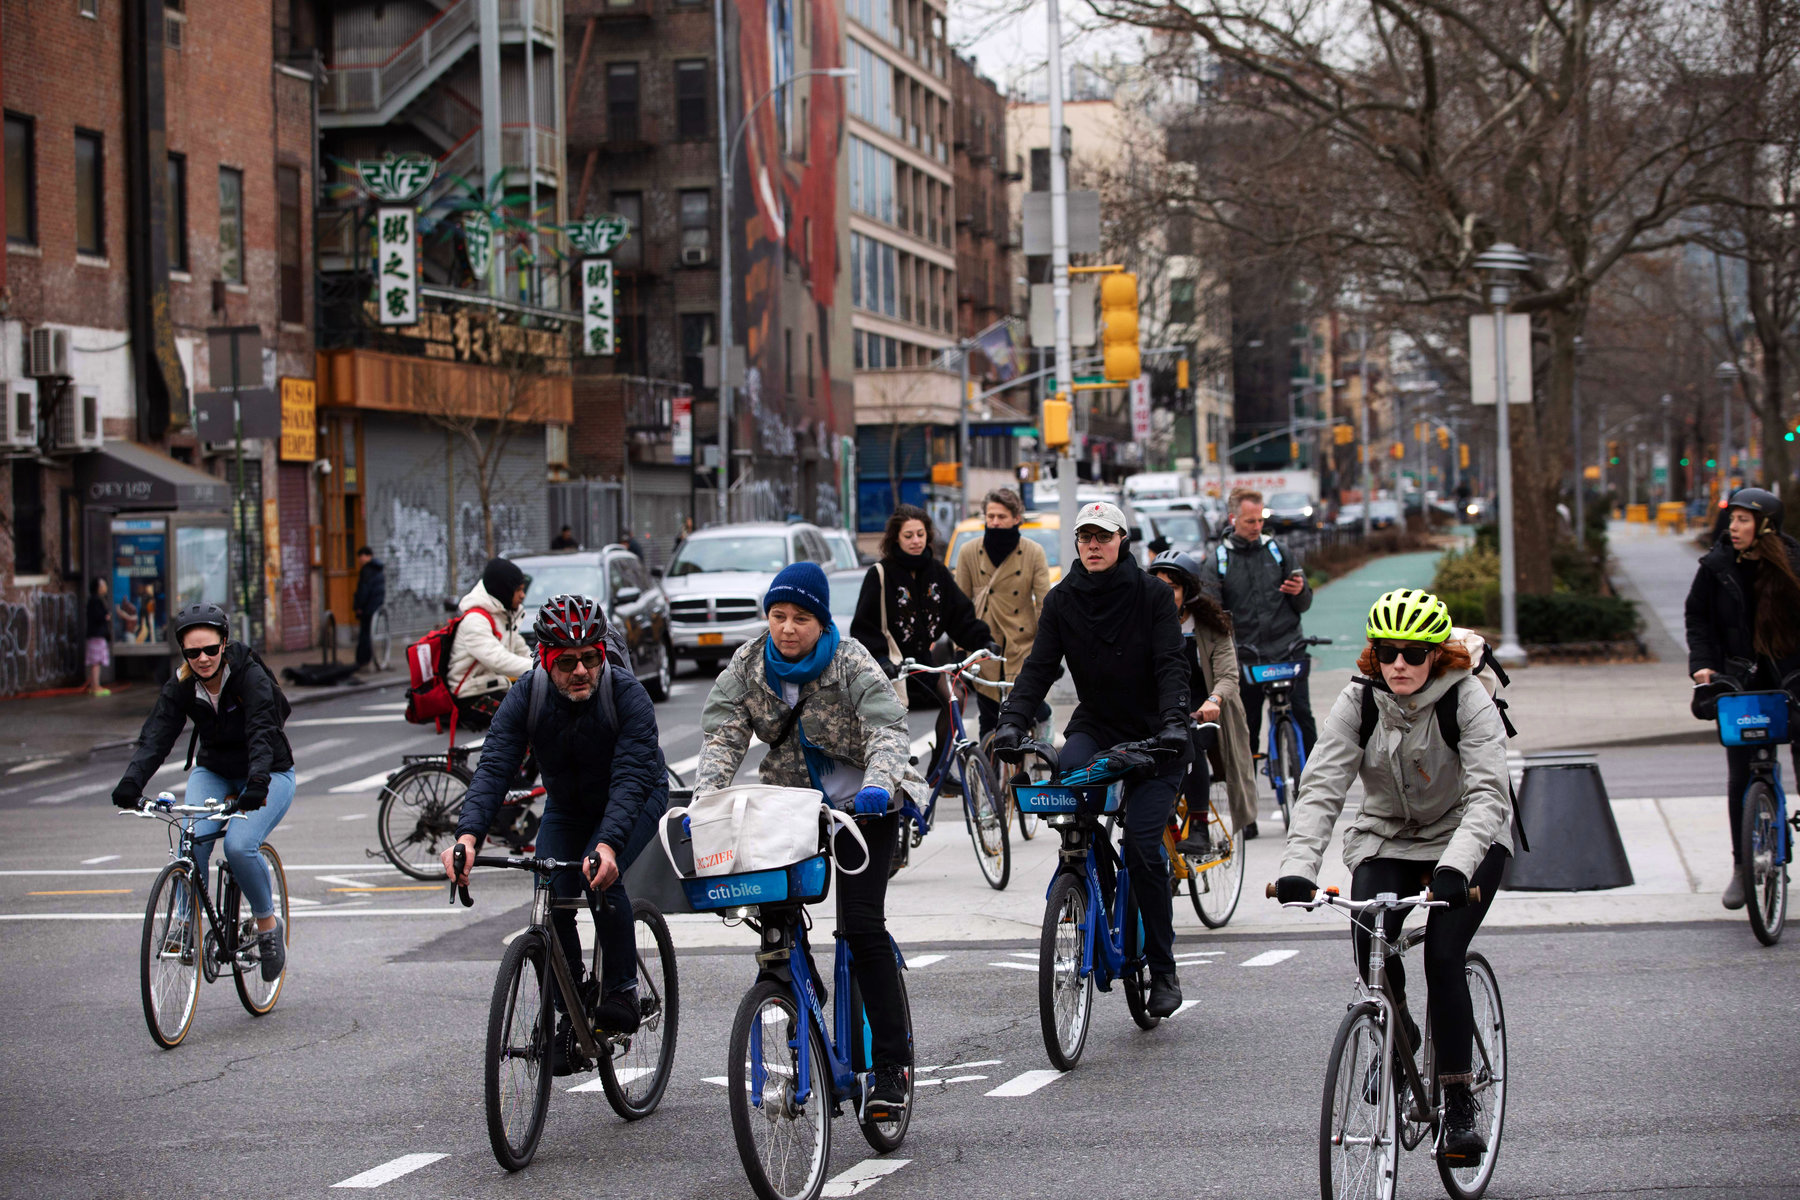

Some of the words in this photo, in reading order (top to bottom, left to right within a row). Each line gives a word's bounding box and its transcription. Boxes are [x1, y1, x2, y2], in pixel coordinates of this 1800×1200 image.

[383, 215, 409, 317] 粥之家
[1030, 793, 1049, 806] citi
[1051, 794, 1077, 806] bike
[708, 884, 730, 900] citi
[731, 883, 762, 898] bike
